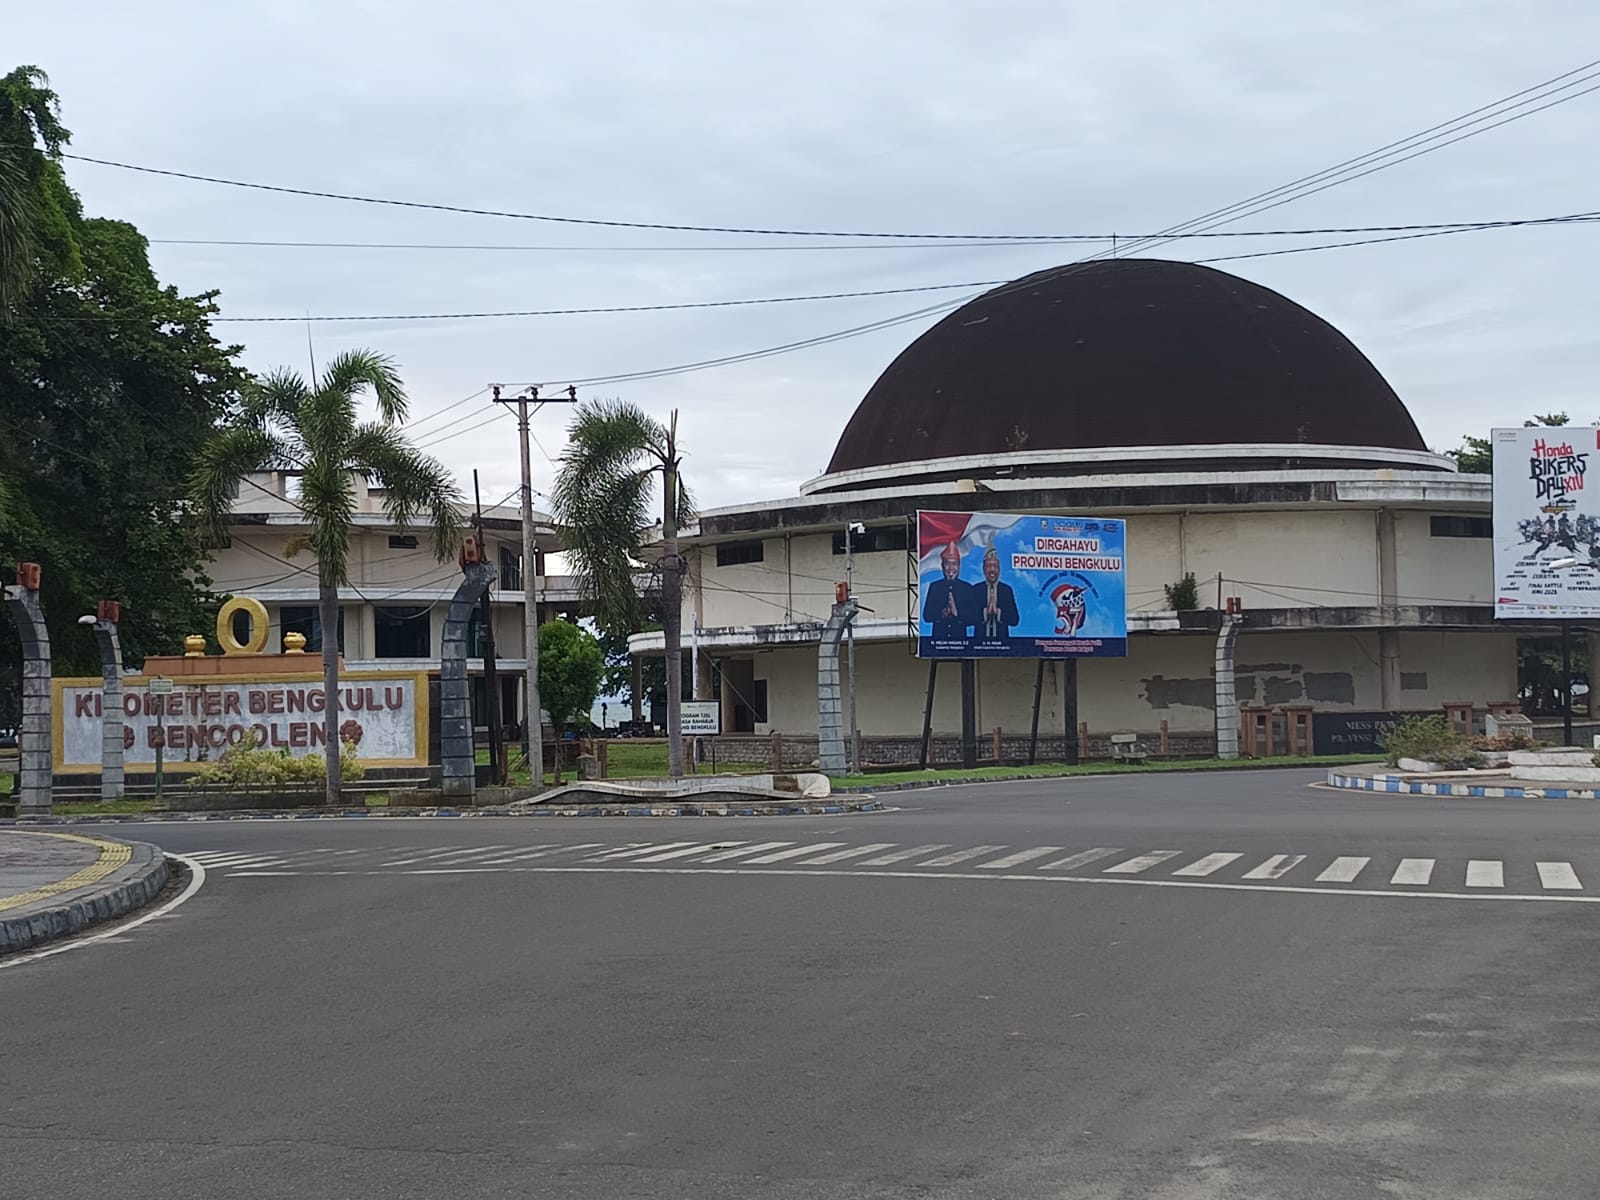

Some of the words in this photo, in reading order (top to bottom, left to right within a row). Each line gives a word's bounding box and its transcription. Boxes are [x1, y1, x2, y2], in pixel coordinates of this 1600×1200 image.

[1532, 438, 1573, 458] Honda
[1530, 453, 1588, 478] BIKERS
[1037, 538, 1098, 552] DIRGAHAYU
[1013, 556, 1063, 568] PROVINSI
[1065, 557, 1120, 570] BENGKULU
[75, 691, 241, 718] KIOMETER
[147, 722, 328, 750] BENCOOLEN
